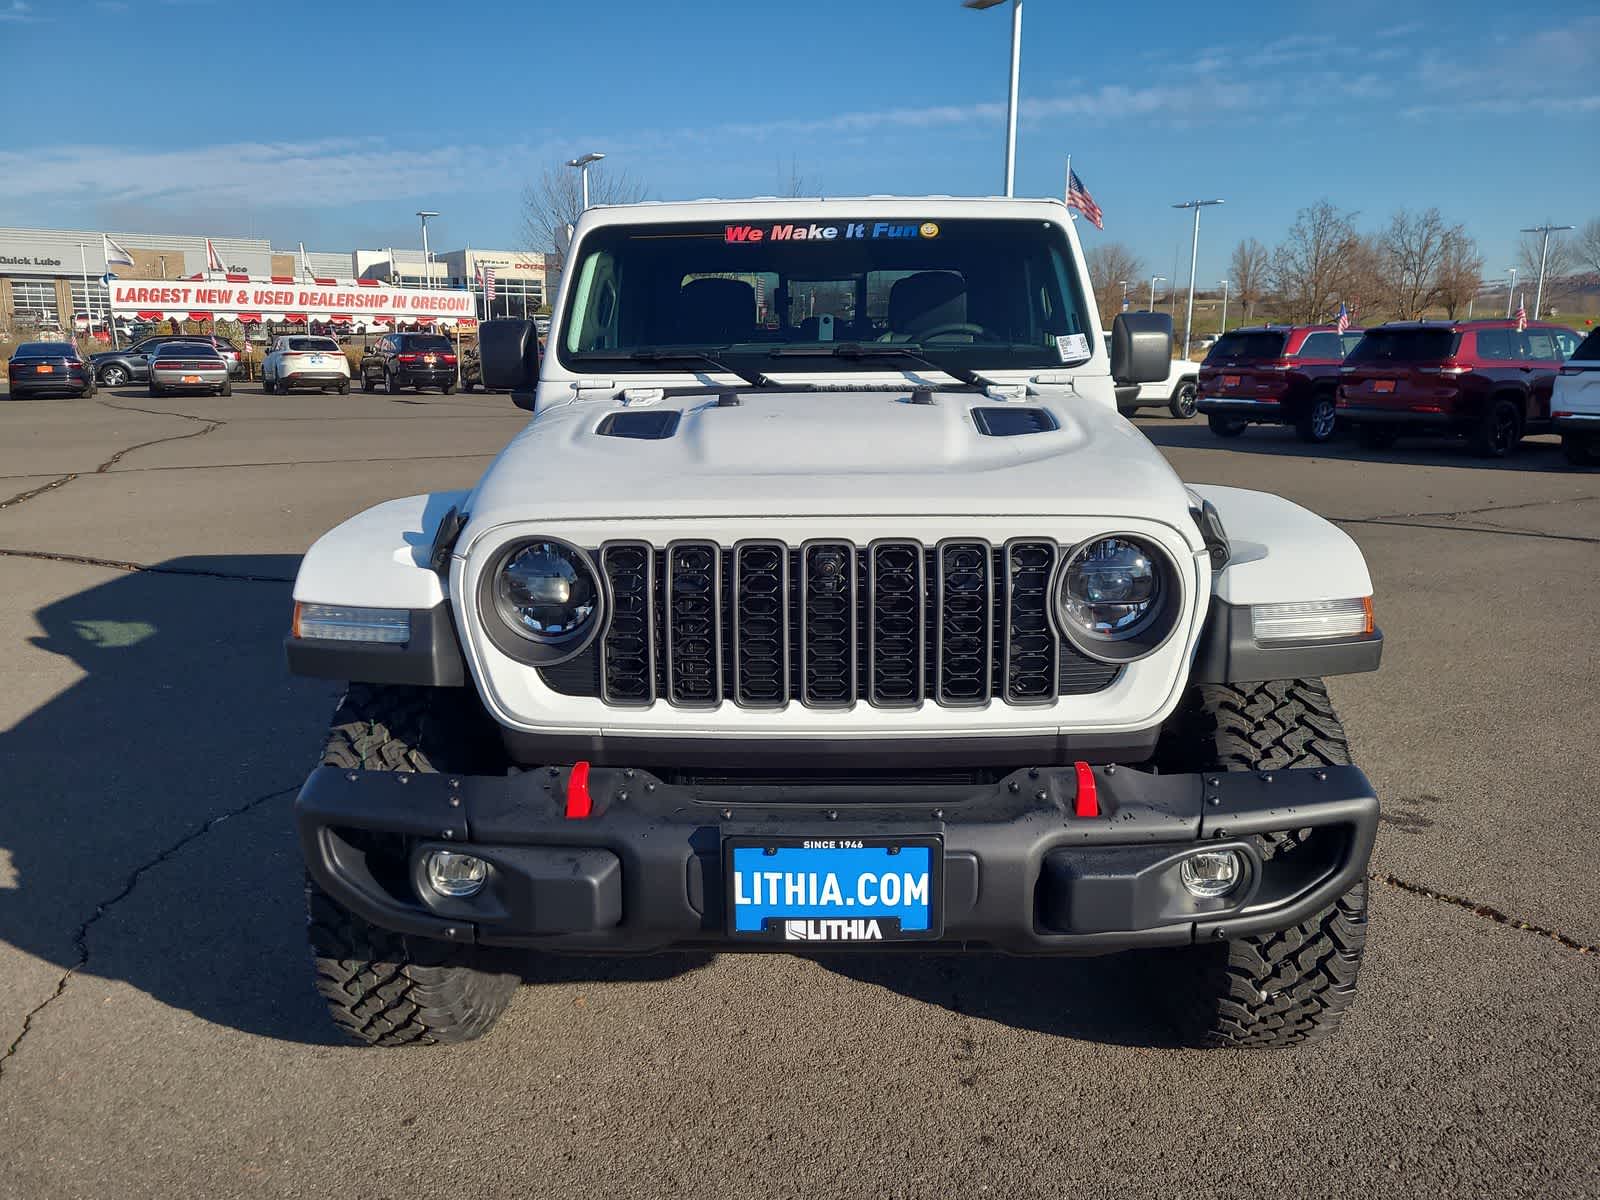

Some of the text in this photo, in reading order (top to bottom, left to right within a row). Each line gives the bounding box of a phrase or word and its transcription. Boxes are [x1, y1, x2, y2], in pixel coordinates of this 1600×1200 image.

[726, 223, 917, 241] We Make It Fun
[0, 256, 62, 266] Quick Lube
[115, 287, 470, 311] LARGEST NEW & USED DEALERSHIP IN OREGON!
[803, 840, 864, 849] SINCE 1946
[735, 871, 929, 906] LITHIA.COM
[807, 919, 883, 940] LITHIA
